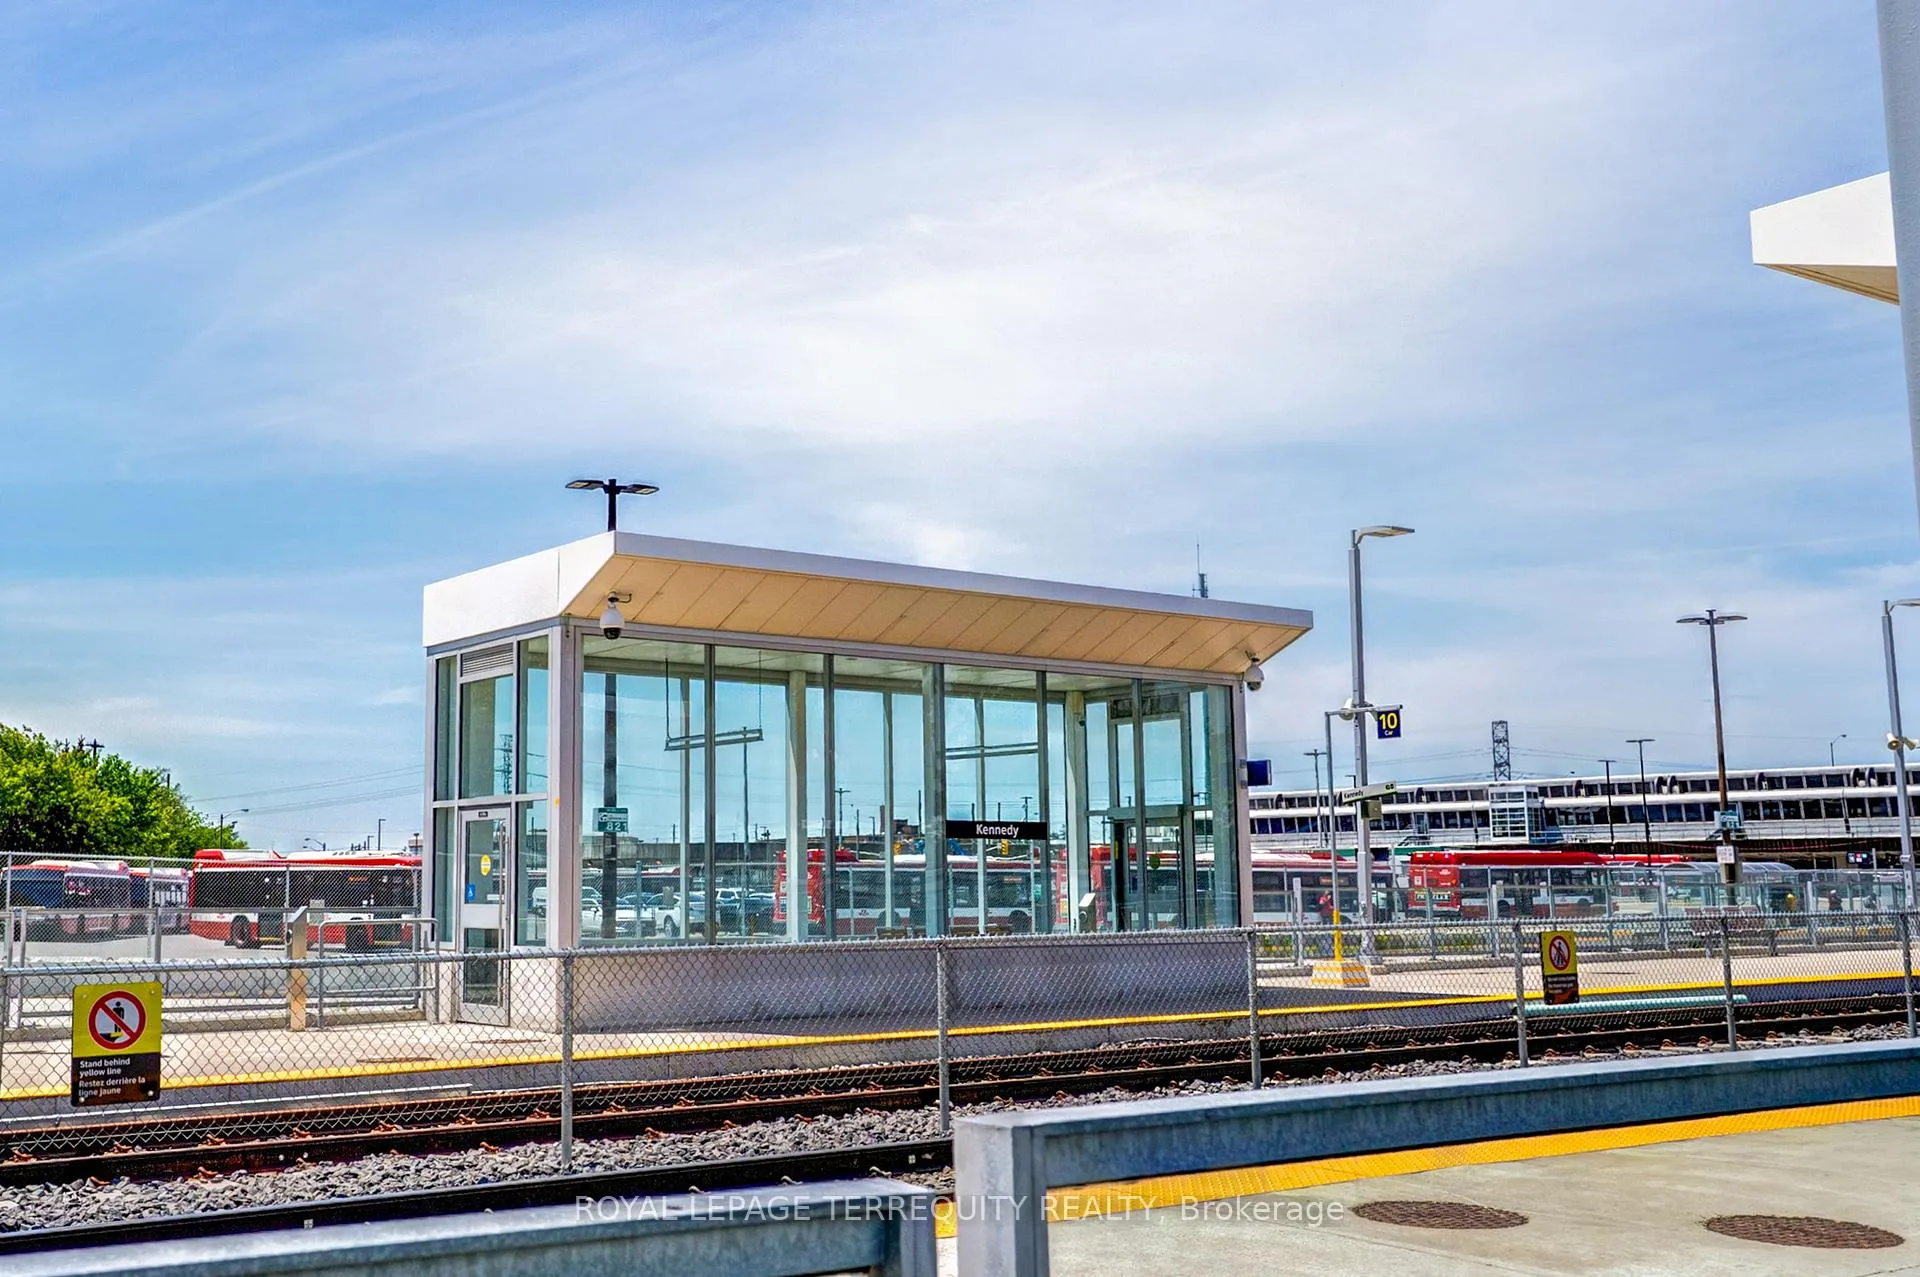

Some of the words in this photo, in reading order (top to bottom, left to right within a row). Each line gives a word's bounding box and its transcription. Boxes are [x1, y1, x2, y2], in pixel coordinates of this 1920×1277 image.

[1379, 712, 1398, 730] 10
[975, 823, 1019, 839] Kennedy
[80, 1060, 102, 1068] Stand
[104, 1058, 130, 1066] behind
[80, 1069, 106, 1078] yellow
[106, 1067, 122, 1075] line
[78, 1080, 105, 1088] Restez
[106, 1078, 136, 1086] derrière
[138, 1076, 146, 1084] la
[78, 1090, 98, 1098] ligne
[99, 1087, 122, 1097] jaune
